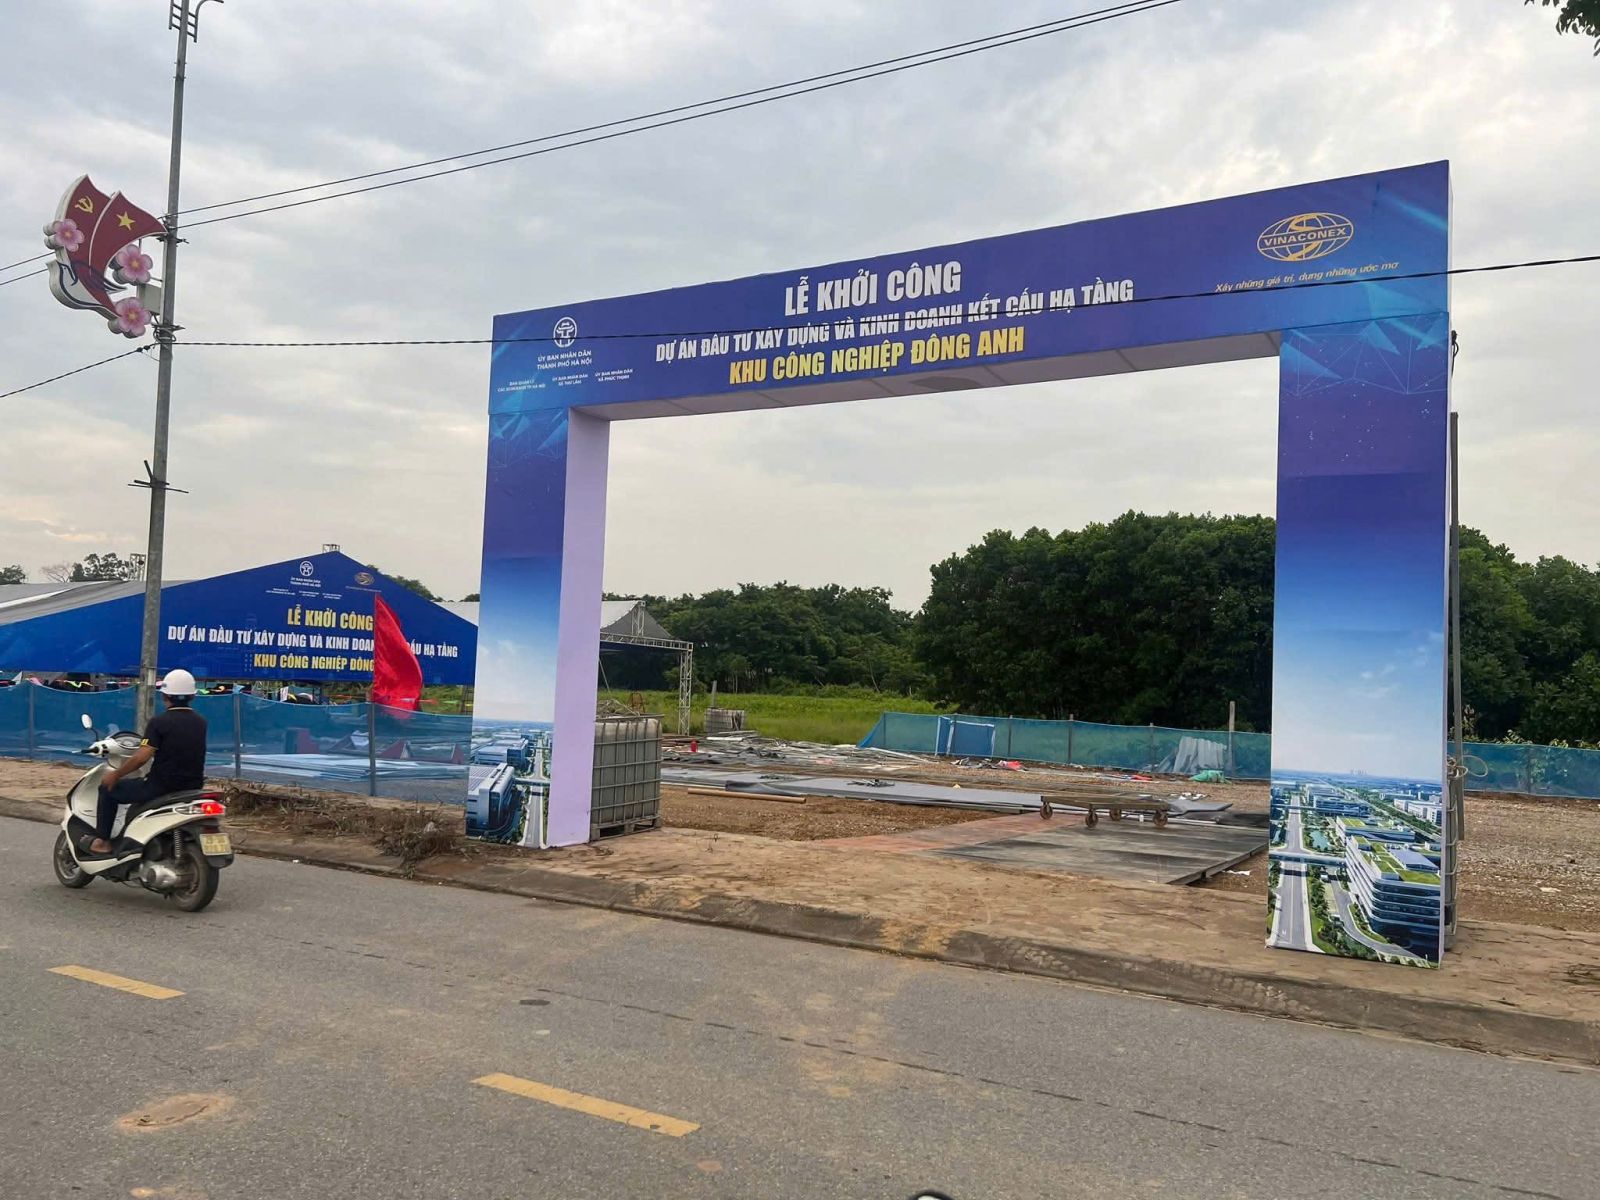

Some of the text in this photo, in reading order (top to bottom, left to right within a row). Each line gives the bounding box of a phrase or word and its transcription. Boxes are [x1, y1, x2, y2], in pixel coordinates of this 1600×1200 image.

[1263, 226, 1347, 247] VINACONEX
[784, 260, 962, 317] LỄ KHỞI CÔNG
[1215, 283, 1233, 293] Xây
[1266, 274, 1281, 287] giá
[1325, 266, 1357, 278] những
[1381, 260, 1400, 270] mơ
[655, 339, 676, 365] DỰ
[677, 337, 697, 360] ÁN
[733, 330, 754, 353] TƯ
[755, 326, 784, 350] XÂY
[787, 322, 830, 348] DỰNG
[834, 316, 855, 340] VÀ
[859, 312, 900, 337] KINH
[904, 303, 963, 331] DOANH
[967, 292, 1001, 323] KẾT
[1005, 287, 1044, 318] CẤU
[1049, 287, 1076, 314] HẠ
[1081, 276, 1134, 305] TẦNG
[537, 361, 556, 370] THÀNH
[560, 351, 577, 359] NHÂN
[578, 349, 592, 357] DÂN
[729, 326, 1025, 385] KHU CÔNG NGHIỆP ĐÔNG ANH
[287, 604, 374, 631] LỄ KHỞI CÔNG
[167, 624, 188, 644] DỰ
[188, 624, 206, 642] ÁN
[208, 624, 234, 644] ĐẦU
[236, 629, 253, 645] TƯ
[253, 630, 275, 646] XÂY
[277, 632, 307, 649] DỰNG
[309, 633, 323, 649] VÀ
[325, 635, 350, 650] KINH
[423, 643, 436, 658] HẠ
[437, 641, 458, 658] TẦNG
[253, 653, 277, 668] KHU
[279, 652, 309, 669] CÔNG
[311, 655, 348, 672] NGHIỆP
